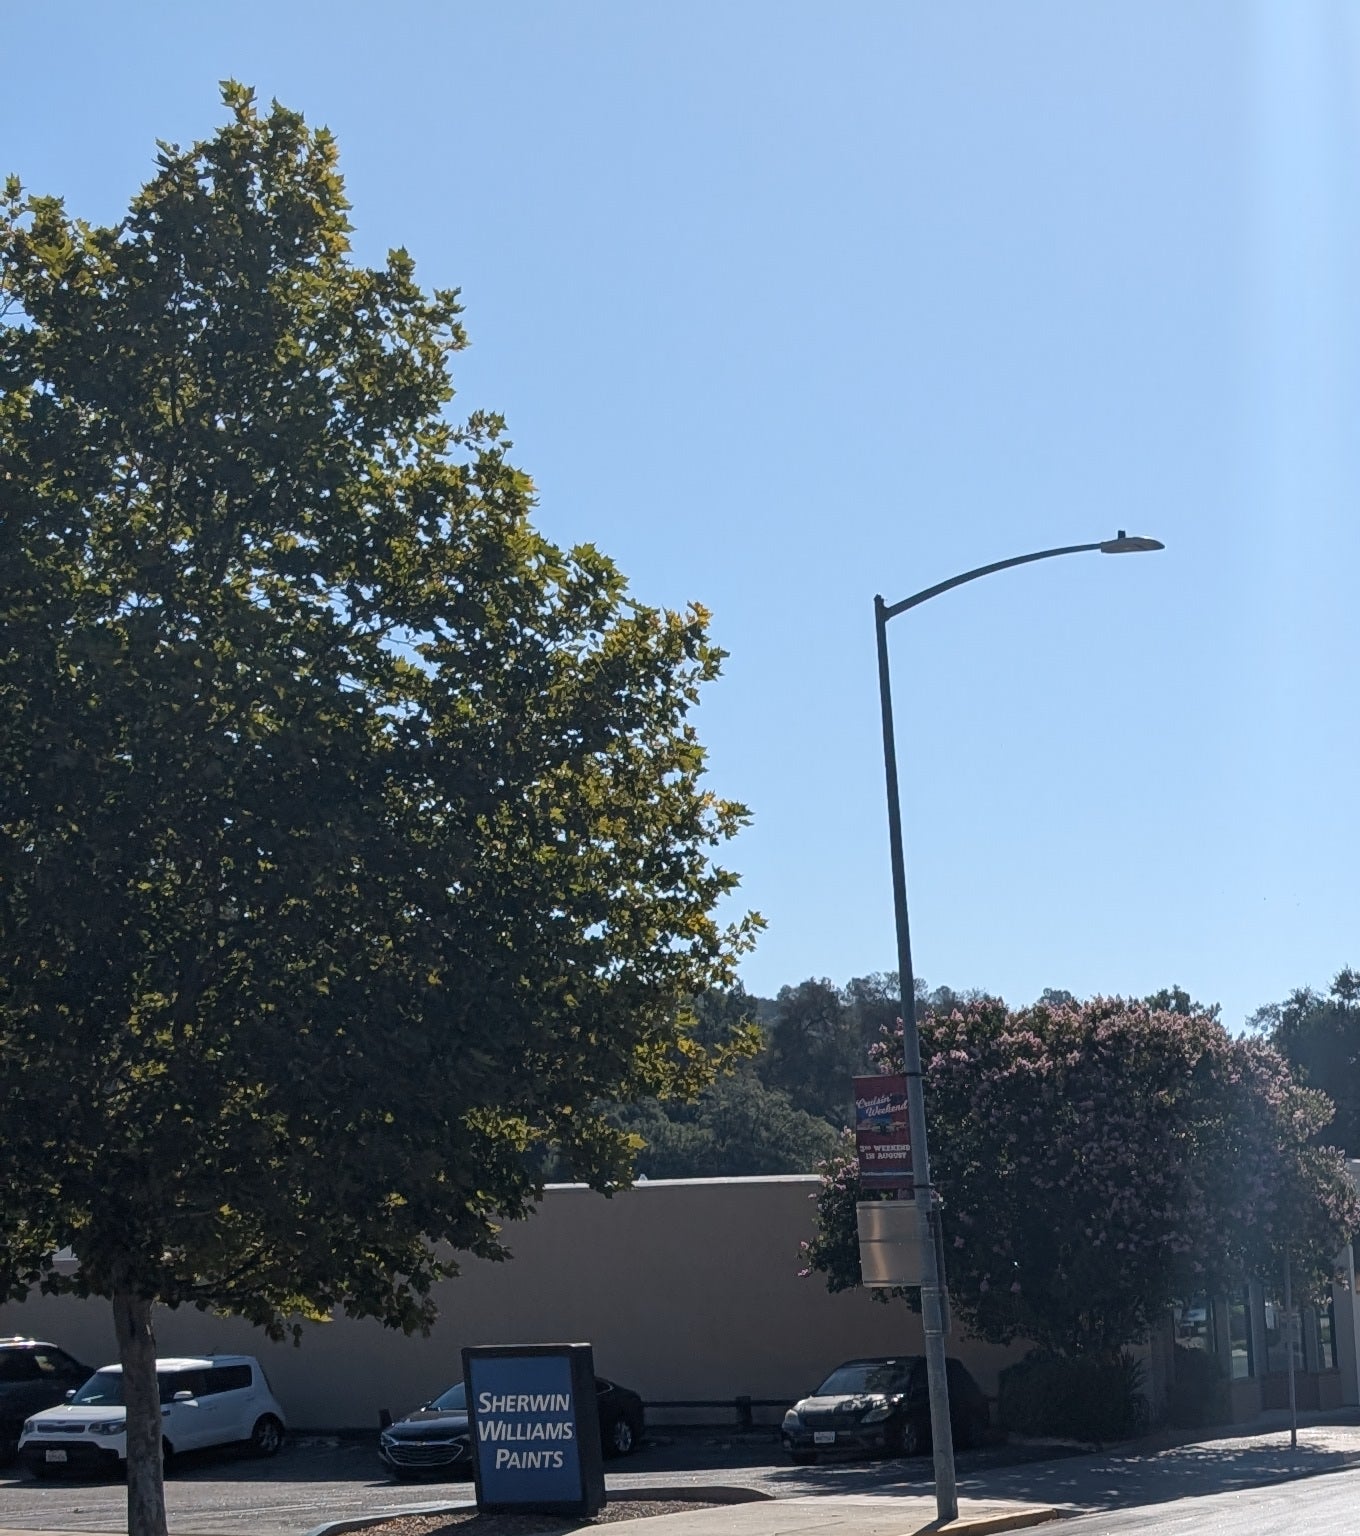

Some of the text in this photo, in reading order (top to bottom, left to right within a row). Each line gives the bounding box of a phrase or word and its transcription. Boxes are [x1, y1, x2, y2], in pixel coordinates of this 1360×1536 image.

[865, 1099, 908, 1117] Weekend
[865, 1151, 907, 1160] IN AUGUST
[873, 1144, 911, 1152] WEEKEND
[478, 1392, 570, 1413] SHERWIN
[478, 1420, 573, 1441] WILLIAMS
[495, 1448, 564, 1469] PAINTS
